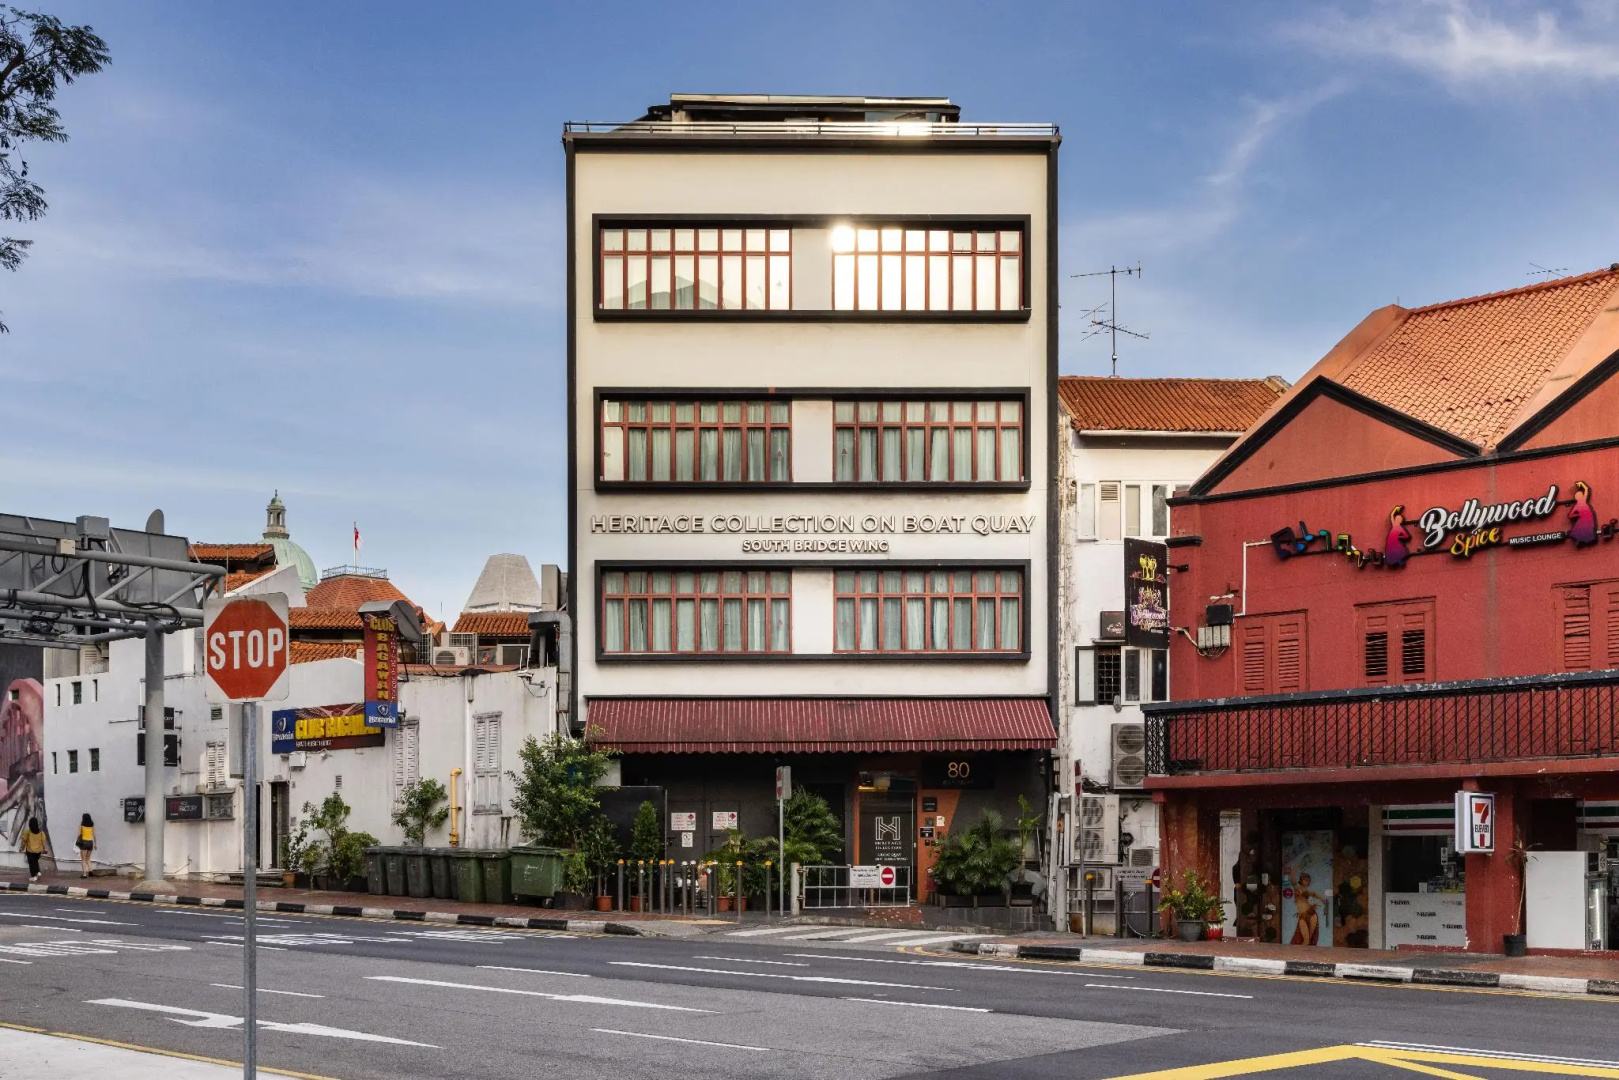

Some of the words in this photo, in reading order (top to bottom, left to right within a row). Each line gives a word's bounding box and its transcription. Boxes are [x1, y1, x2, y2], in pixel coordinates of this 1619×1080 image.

[591, 515, 704, 533] HERITAGE
[711, 515, 854, 533] COLLECTION
[861, 515, 895, 533] ON
[903, 515, 965, 533] BOAT
[971, 515, 1036, 535] QUAY
[1419, 484, 1557, 547] Bollywood
[742, 540, 790, 552] SOUTH
[794, 540, 846, 552] BRIDGE
[848, 540, 889, 552] WING
[1450, 527, 1500, 556] Spice
[1509, 536, 1532, 545] MUSIC
[1532, 532, 1562, 542] LOUNGE
[209, 627, 284, 671] STOP
[376, 632, 389, 700] BAGAWAN
[295, 718, 325, 740] CLUB
[947, 761, 970, 778] 80
[1474, 802, 1489, 840] 7
